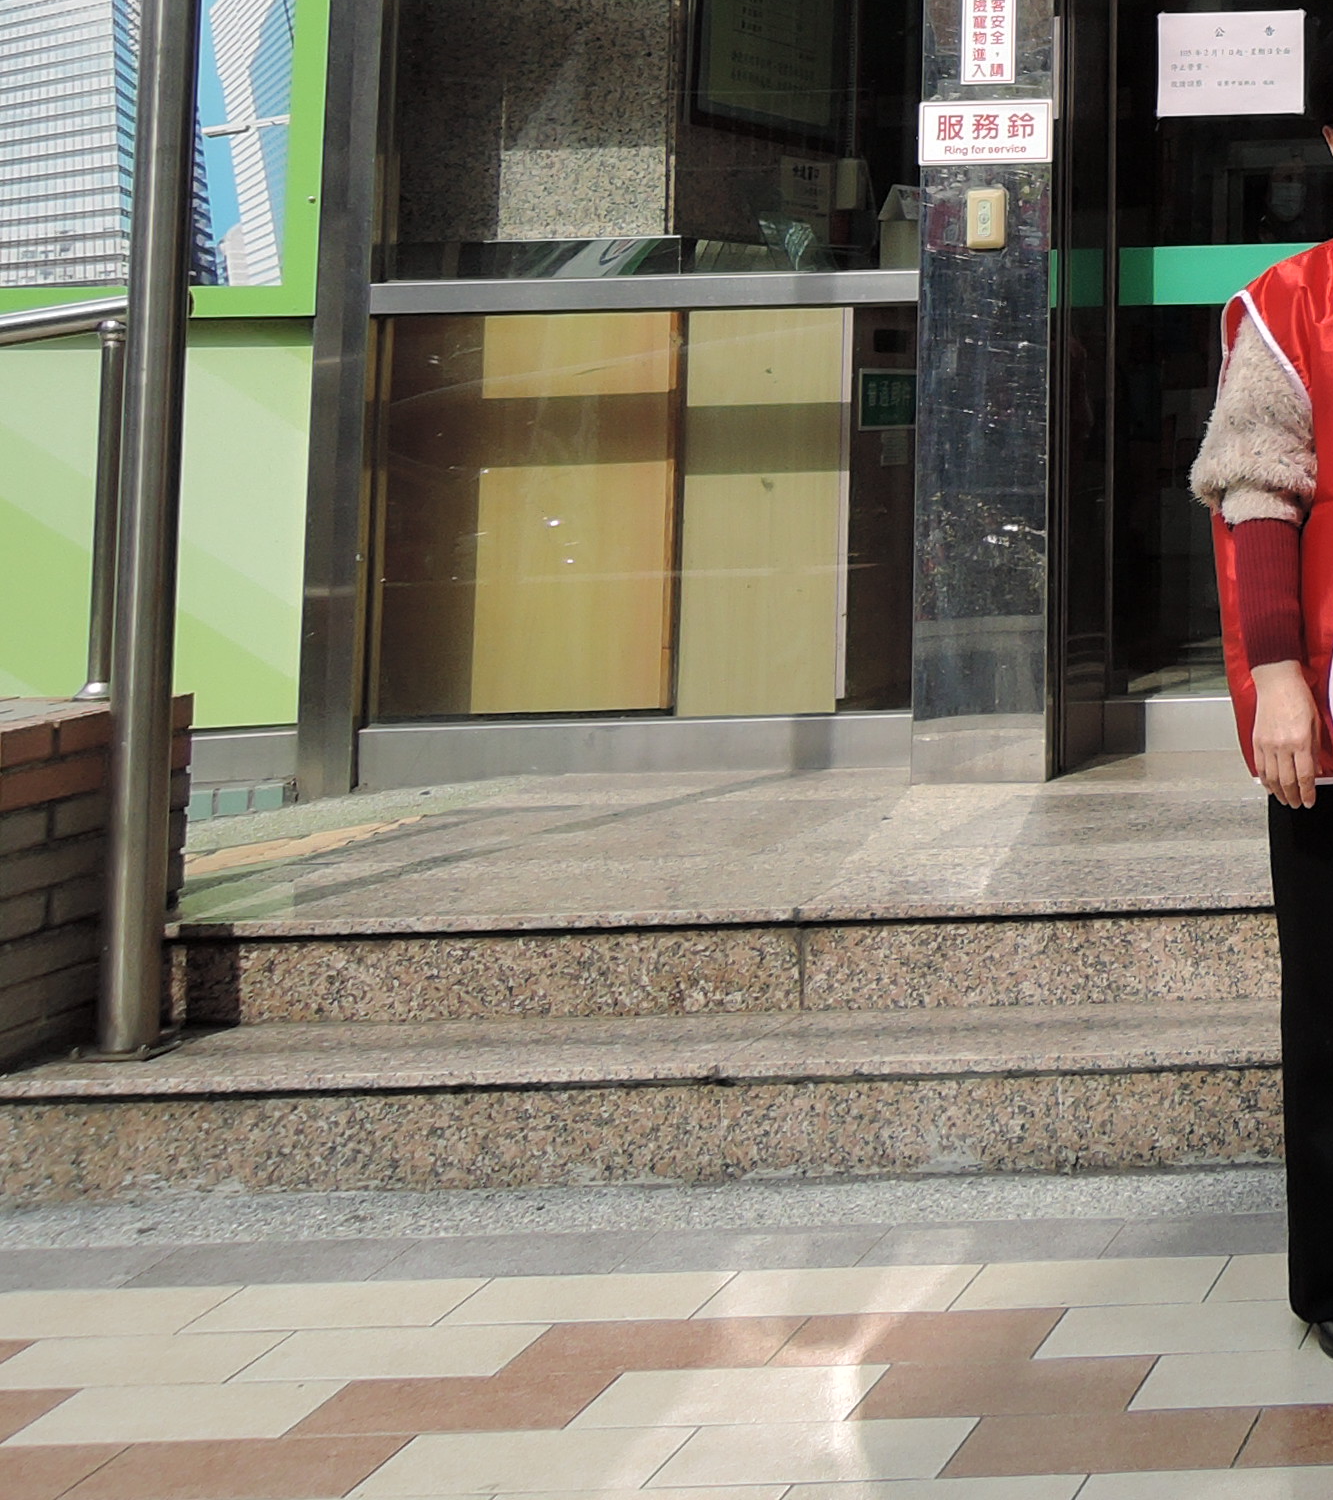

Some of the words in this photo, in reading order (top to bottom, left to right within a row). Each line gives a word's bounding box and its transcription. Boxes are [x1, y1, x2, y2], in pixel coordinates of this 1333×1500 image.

[936, 112, 1035, 141] 服務鈴
[944, 145, 969, 157] Ring
[971, 144, 986, 155] for
[987, 144, 1027, 155] service
